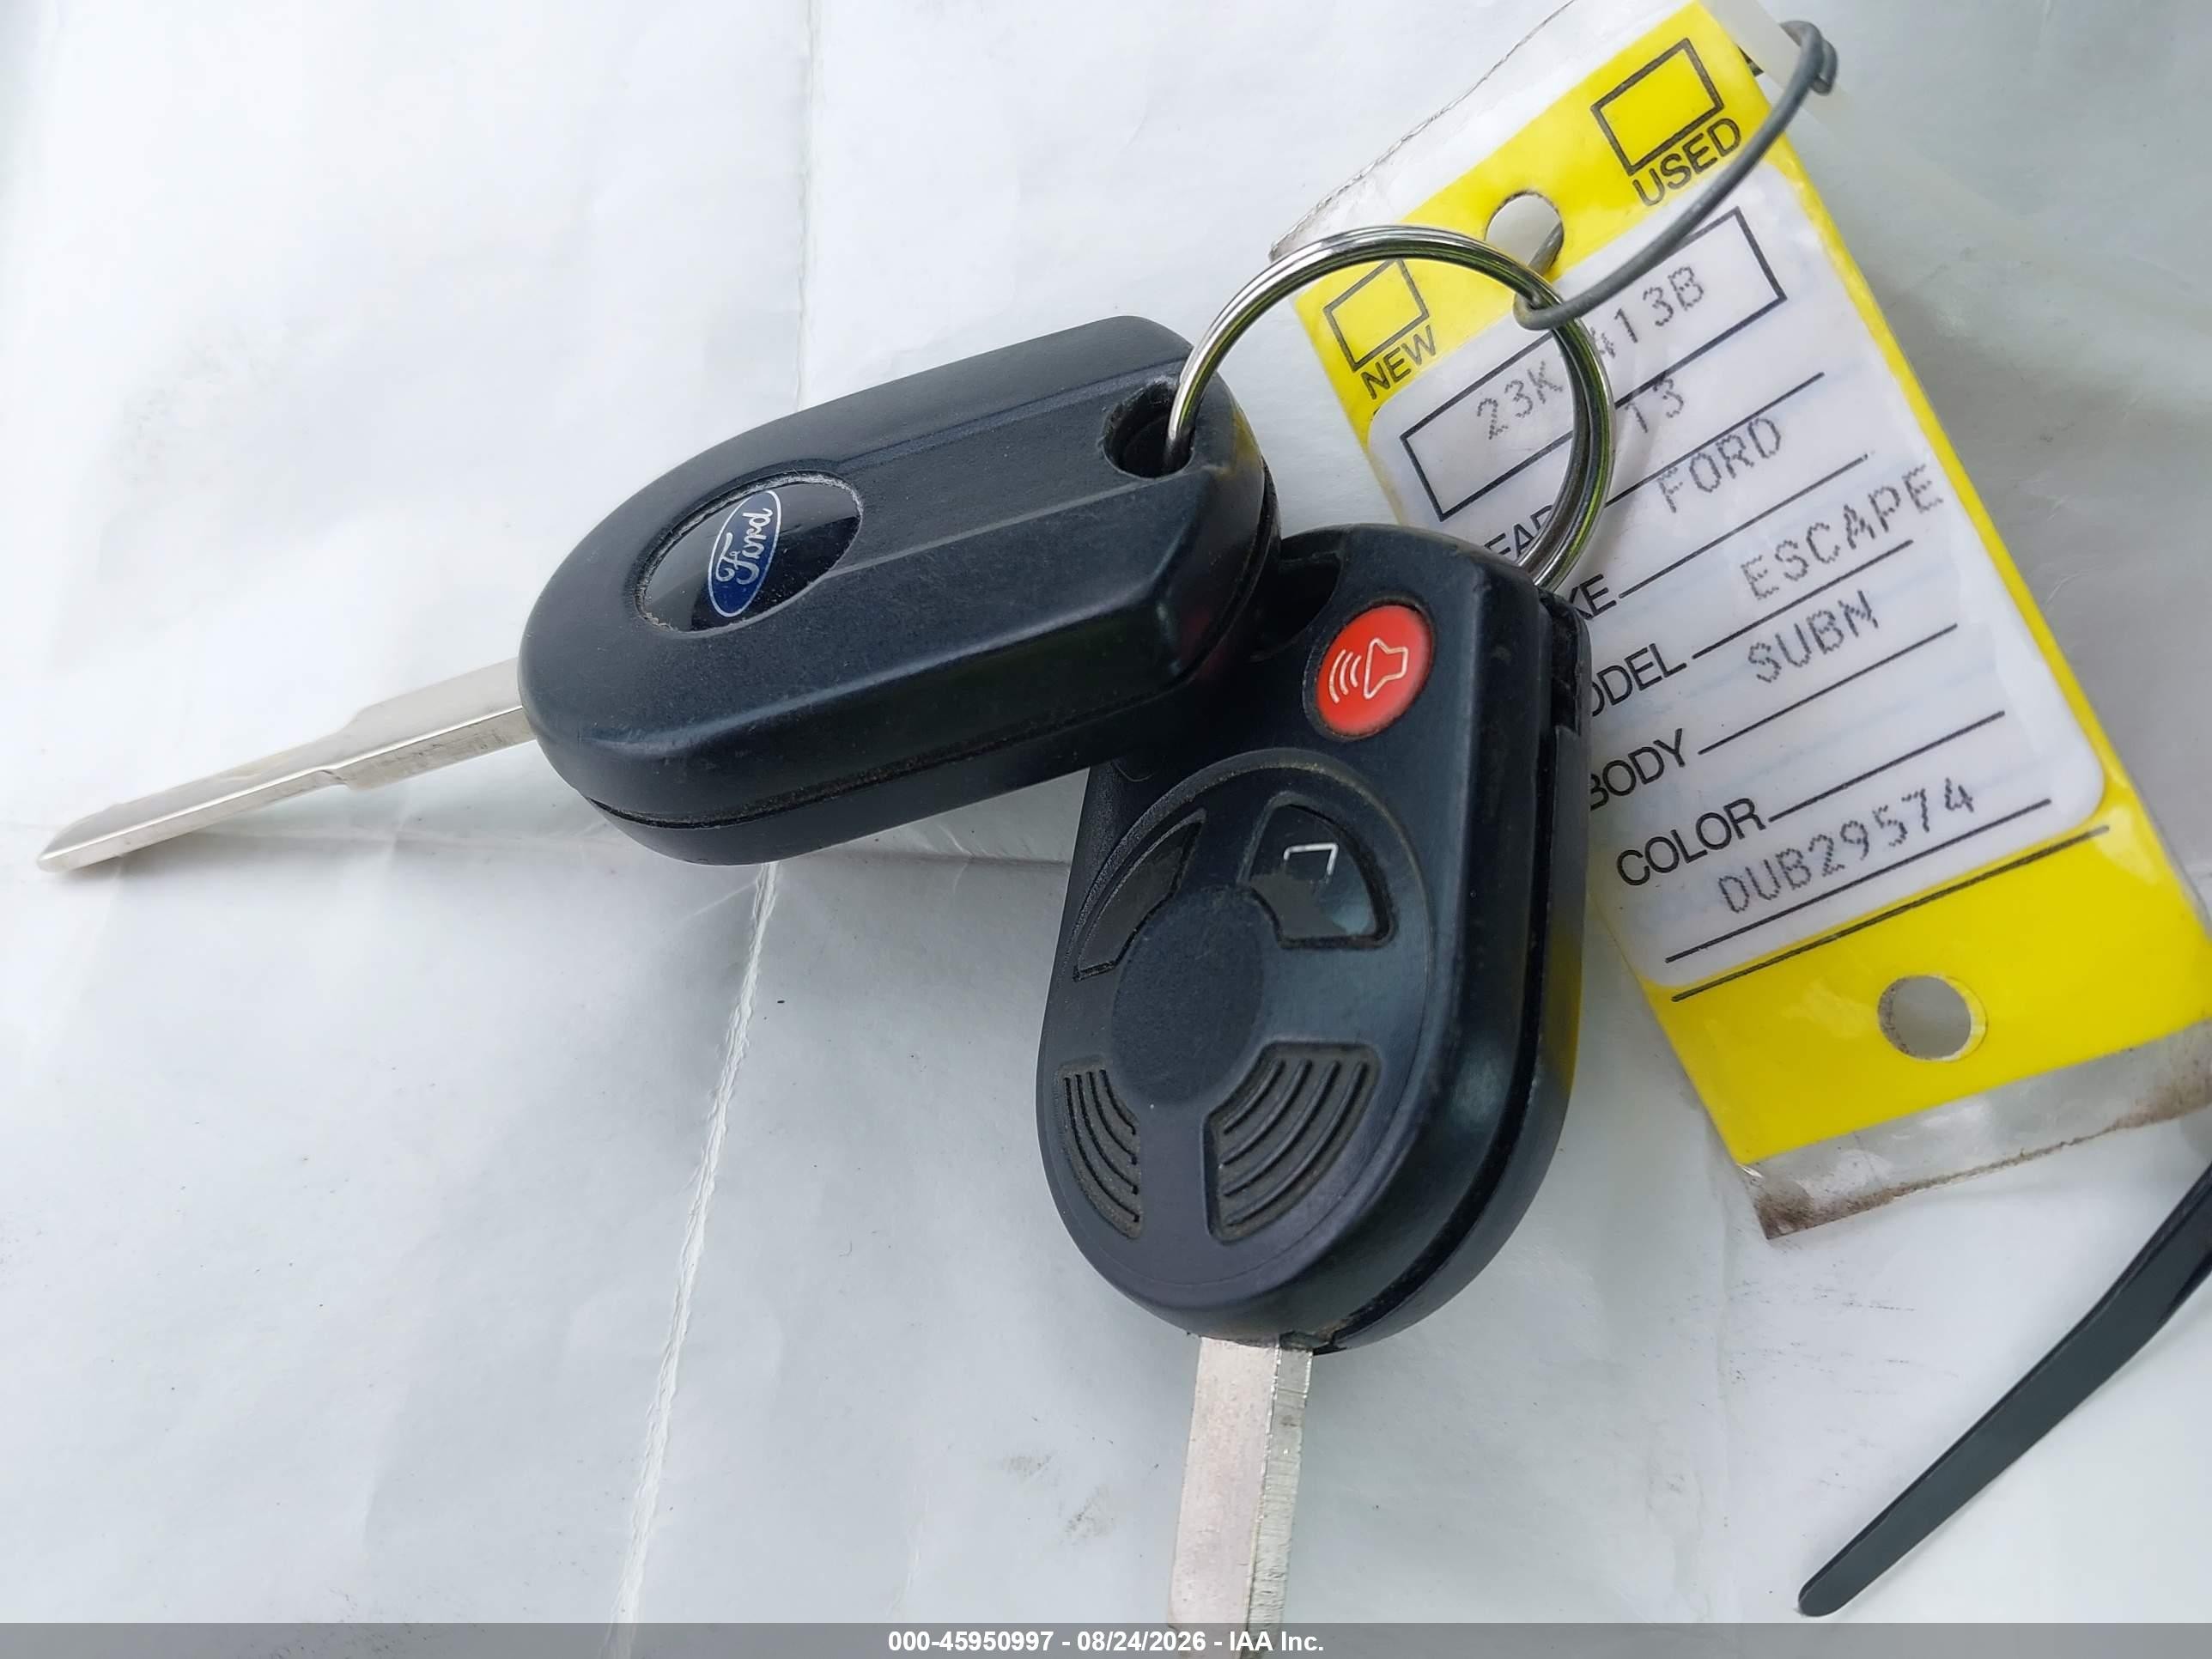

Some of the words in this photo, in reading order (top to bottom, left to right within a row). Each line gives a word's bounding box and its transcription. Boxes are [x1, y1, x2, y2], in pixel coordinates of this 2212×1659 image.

[1632, 118, 1741, 206] USED
[1360, 325, 1437, 399] NEW
[1477, 266, 1704, 440] 23K413B
[1624, 377, 1684, 433] 13
[1657, 417, 1782, 513] FORD
[715, 507, 773, 585] Ford
[1591, 643, 1687, 717] DEL
[1741, 464, 1943, 601] ESCAPE
[1747, 591, 1879, 684] SUBN
[1615, 798, 1768, 887] COLOR
[1718, 778, 1975, 914] DUB29574
